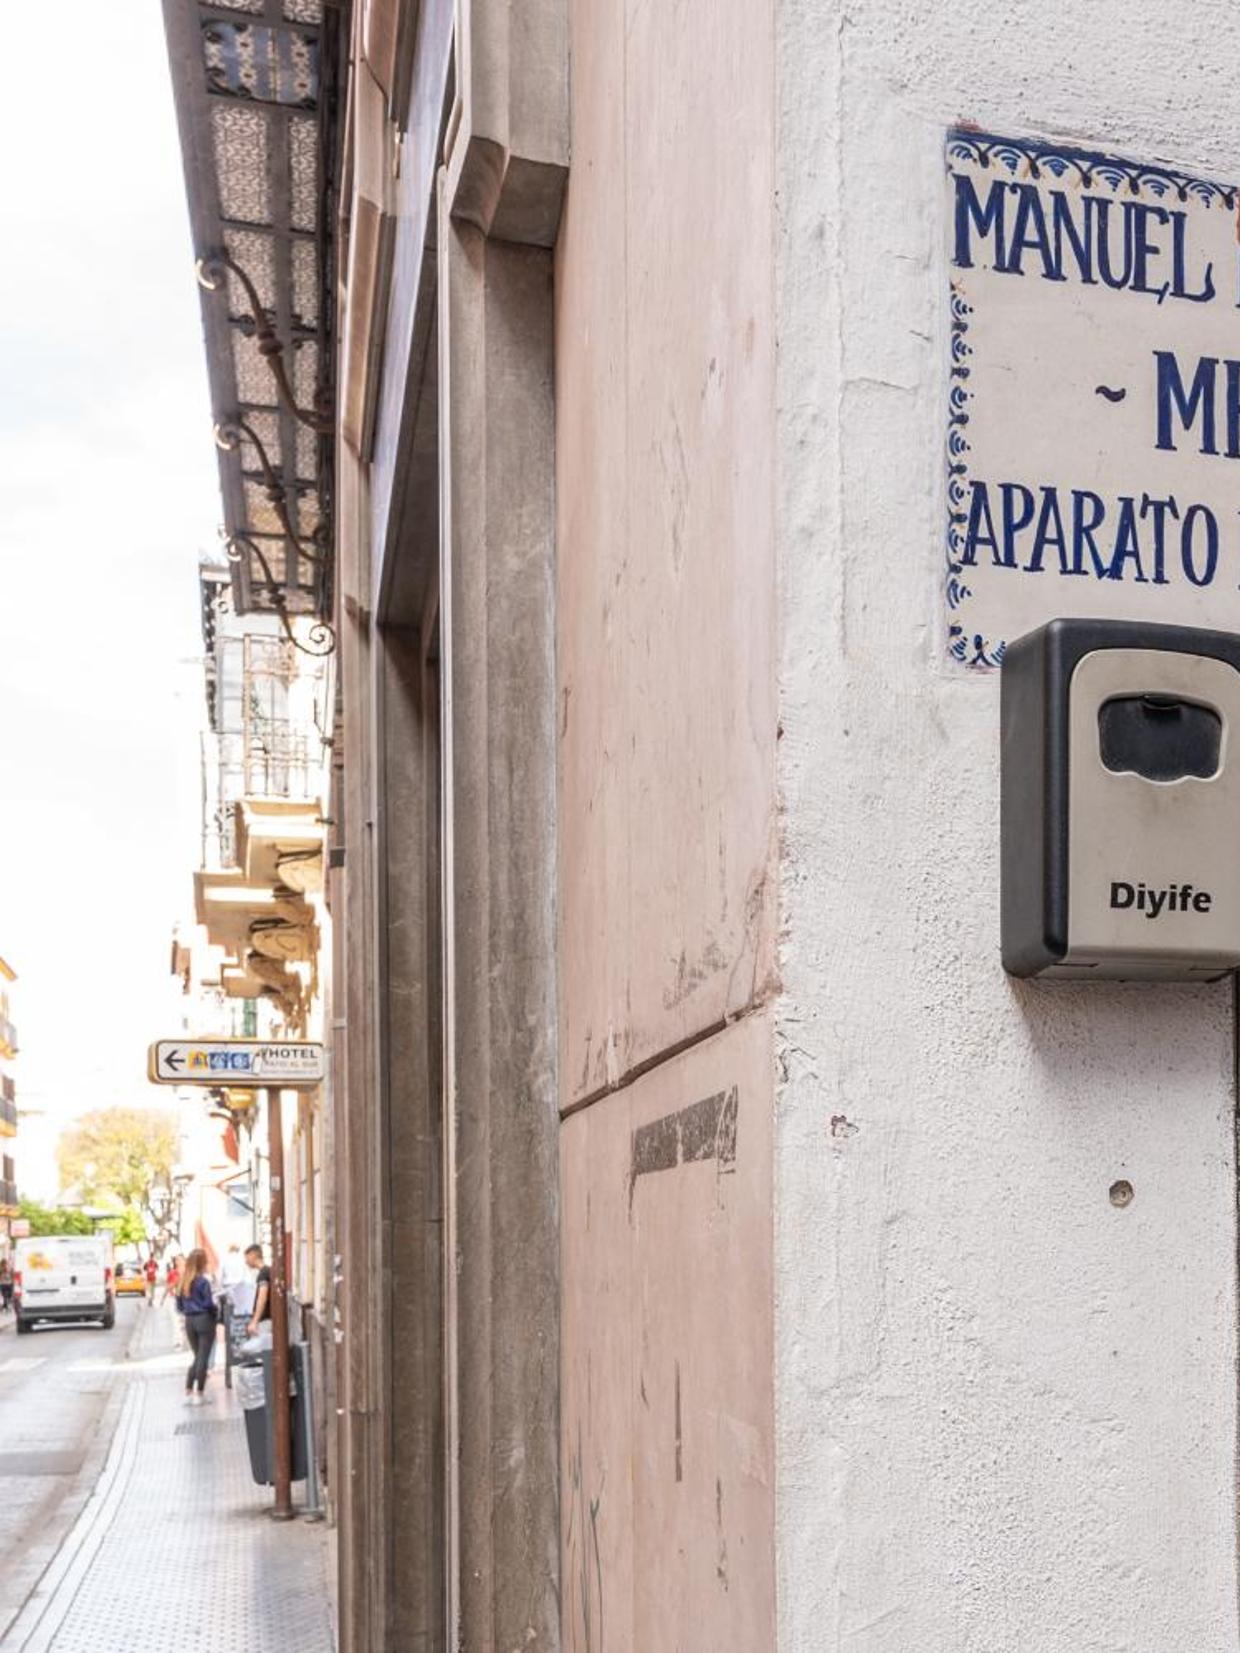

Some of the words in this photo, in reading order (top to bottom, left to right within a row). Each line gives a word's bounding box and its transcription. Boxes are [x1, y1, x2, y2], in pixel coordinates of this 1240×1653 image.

[952, 174, 1215, 304] MANUEL
[963, 480, 1219, 587] APARATO
[1110, 882, 1212, 918] Diyife
[269, 1047, 318, 1058] HOTEL
